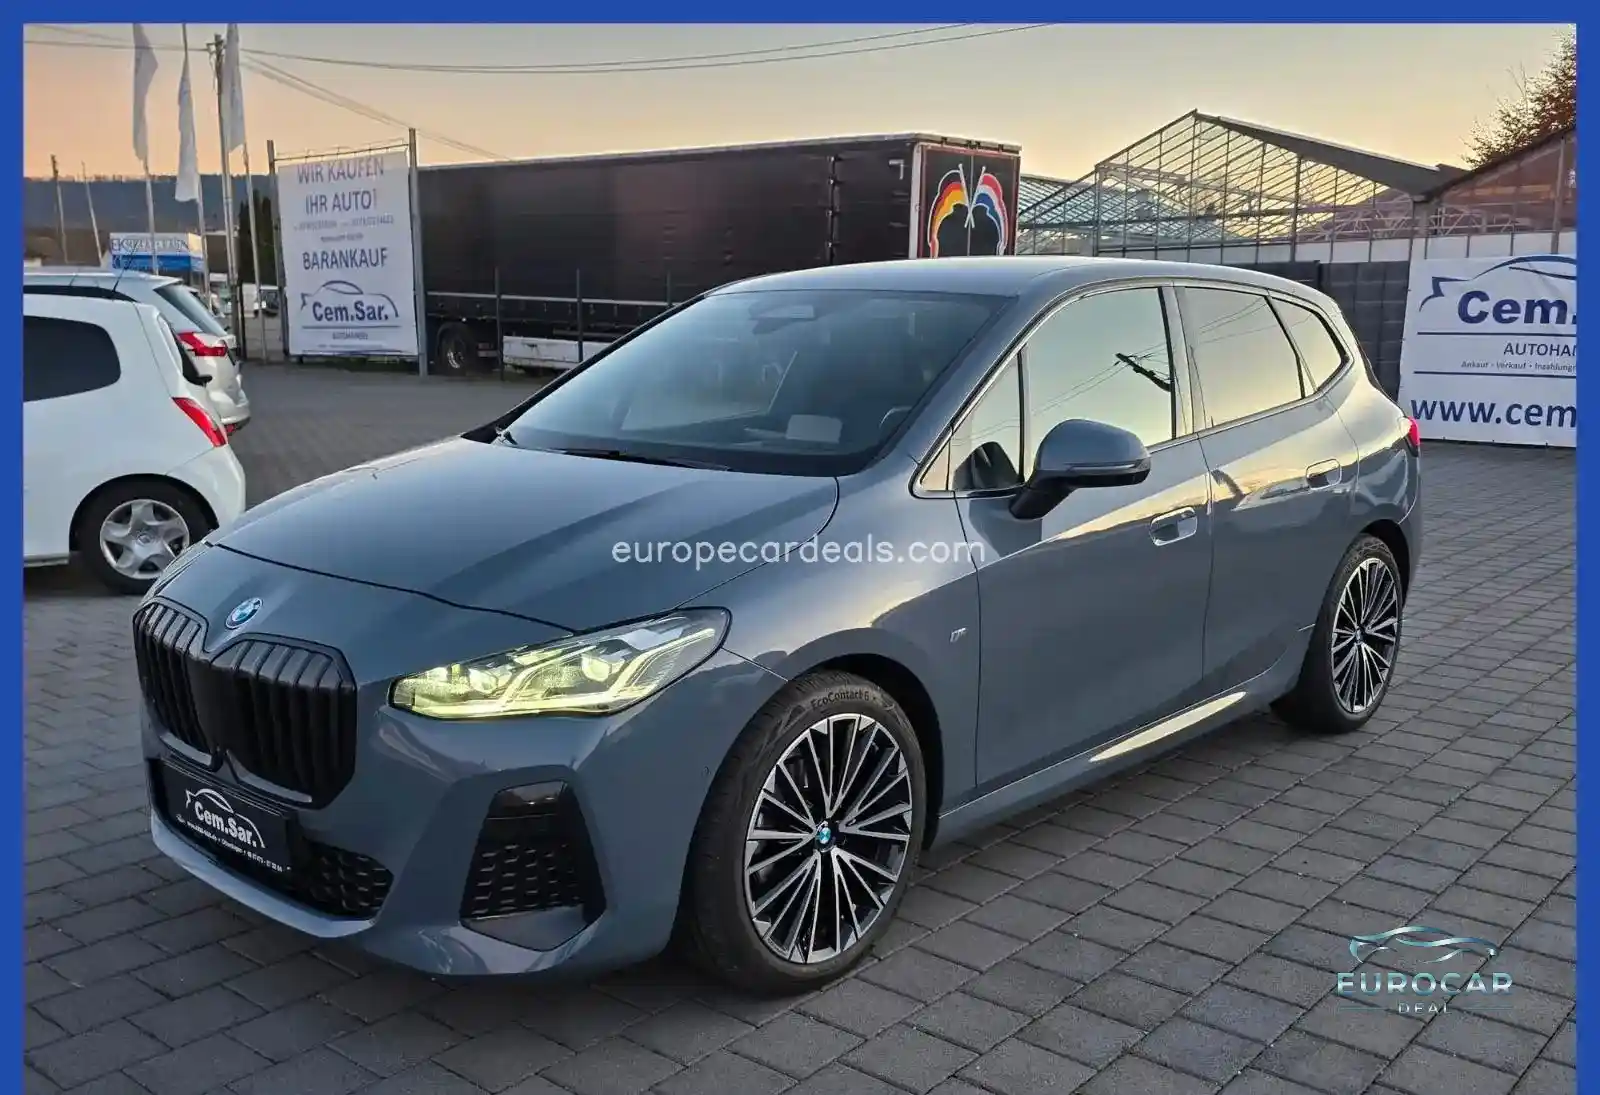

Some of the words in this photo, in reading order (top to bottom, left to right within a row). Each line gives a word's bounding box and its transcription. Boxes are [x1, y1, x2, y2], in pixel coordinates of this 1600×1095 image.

[297, 164, 325, 185] WIR
[327, 156, 384, 183] KAUFEN
[305, 194, 328, 215] IHR
[331, 188, 378, 213] AUTO!
[302, 247, 388, 271] BARANKAUF
[312, 300, 389, 323] Cem.Sar.
[1497, 361, 1527, 370] Verkauf
[1410, 399, 1577, 428] www.cem
[810, 689, 862, 709] EcoContact
[194, 800, 258, 848] Cem.Sar.
